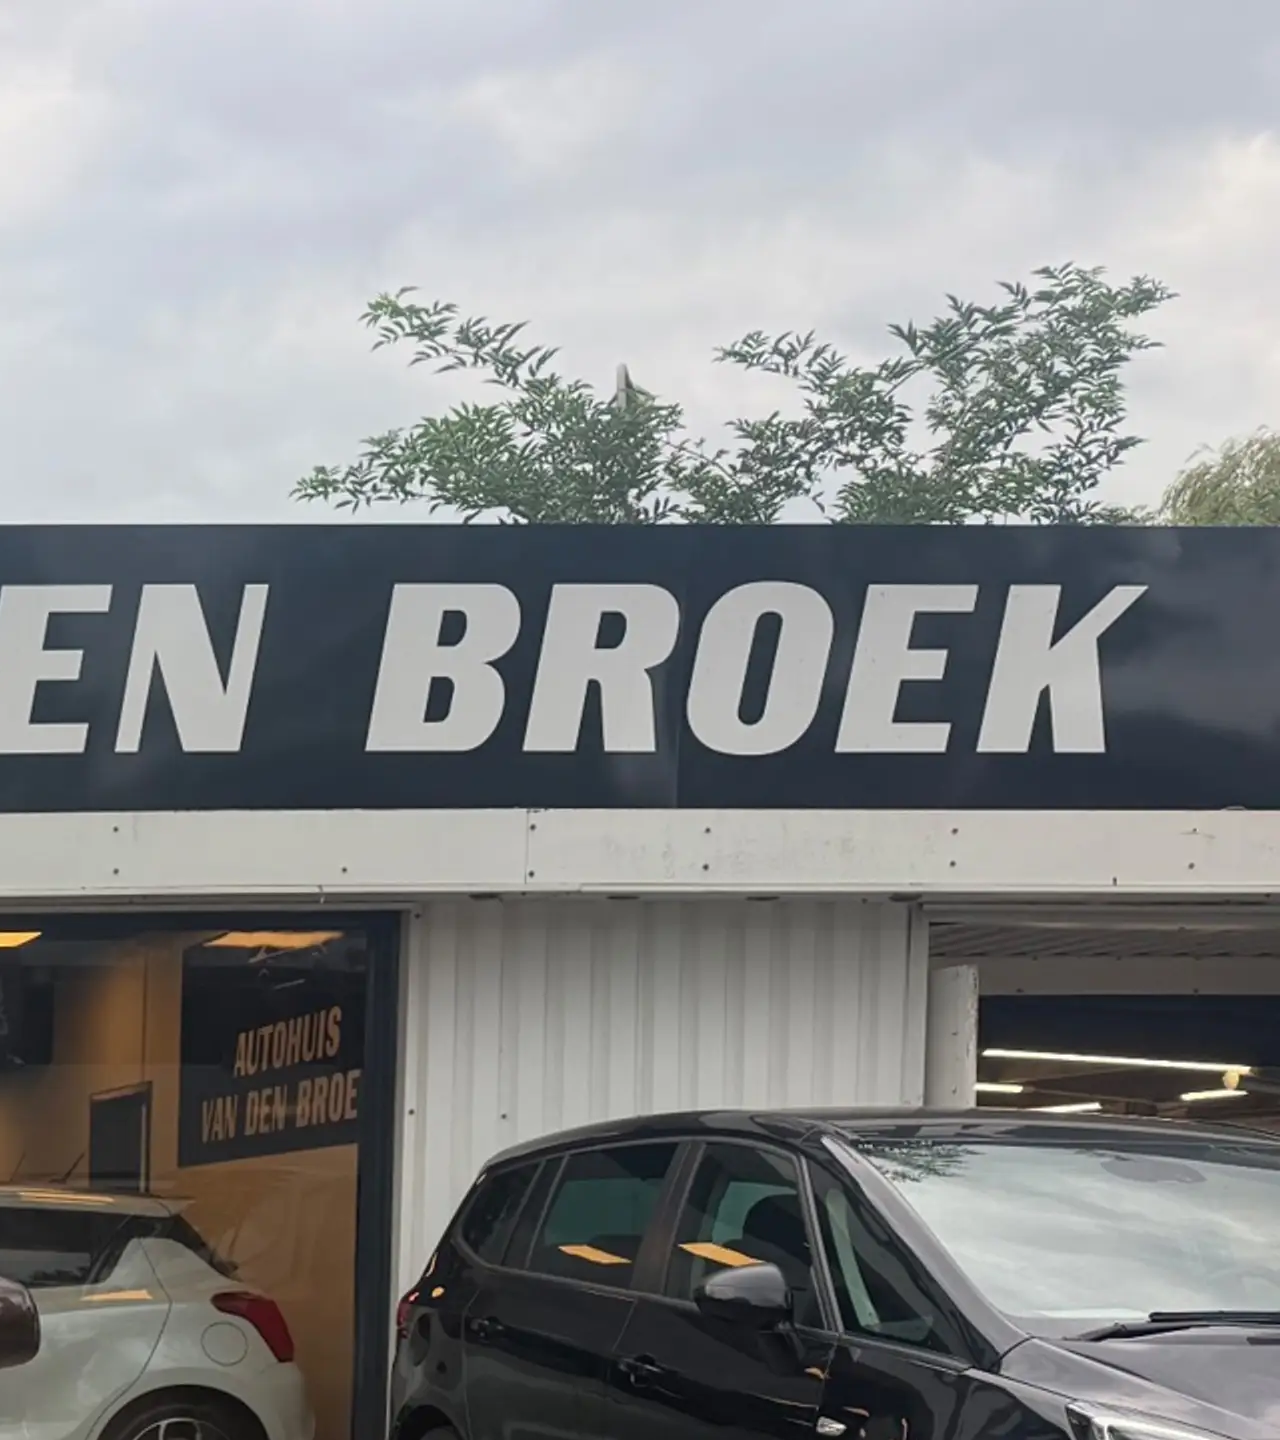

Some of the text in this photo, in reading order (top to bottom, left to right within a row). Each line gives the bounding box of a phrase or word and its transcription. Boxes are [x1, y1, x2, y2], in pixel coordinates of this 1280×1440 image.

[365, 582, 1148, 756] BROEK
[233, 1005, 342, 1078] AUTOHUIS
[201, 1094, 239, 1144] VAN
[244, 1084, 288, 1136] DEN
